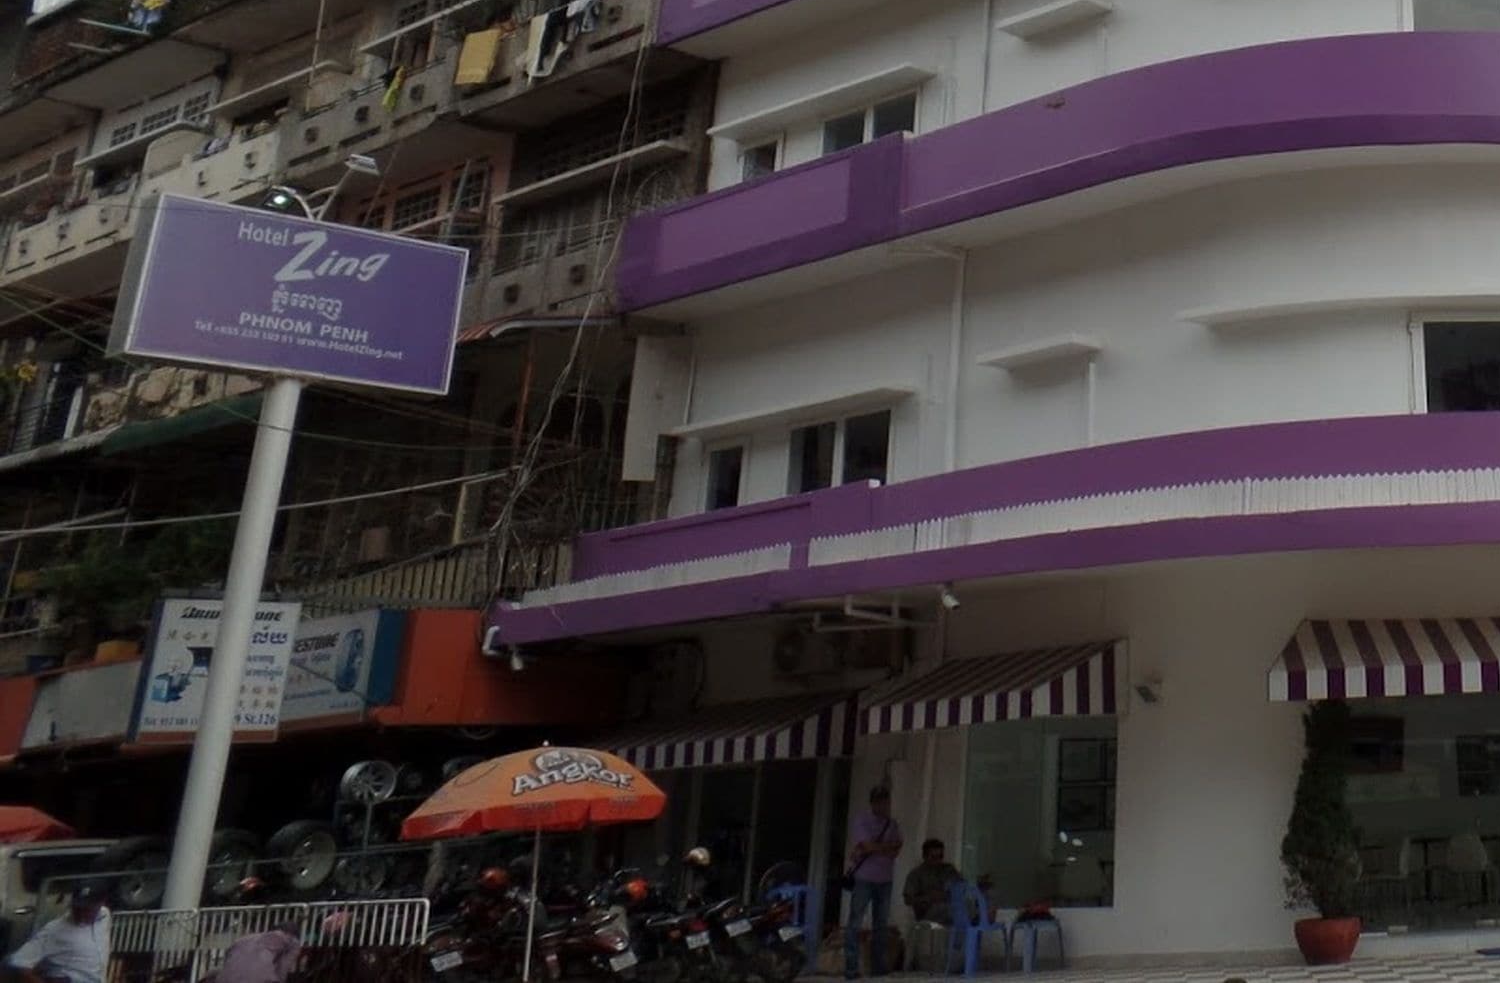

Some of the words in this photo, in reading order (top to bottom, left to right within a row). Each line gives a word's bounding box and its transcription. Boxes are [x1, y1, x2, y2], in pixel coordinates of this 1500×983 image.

[238, 221, 289, 247] Hotel
[273, 230, 391, 283] Zing
[239, 312, 312, 335] PHNOM
[319, 323, 369, 344] PENH
[511, 761, 634, 796] Angkor
